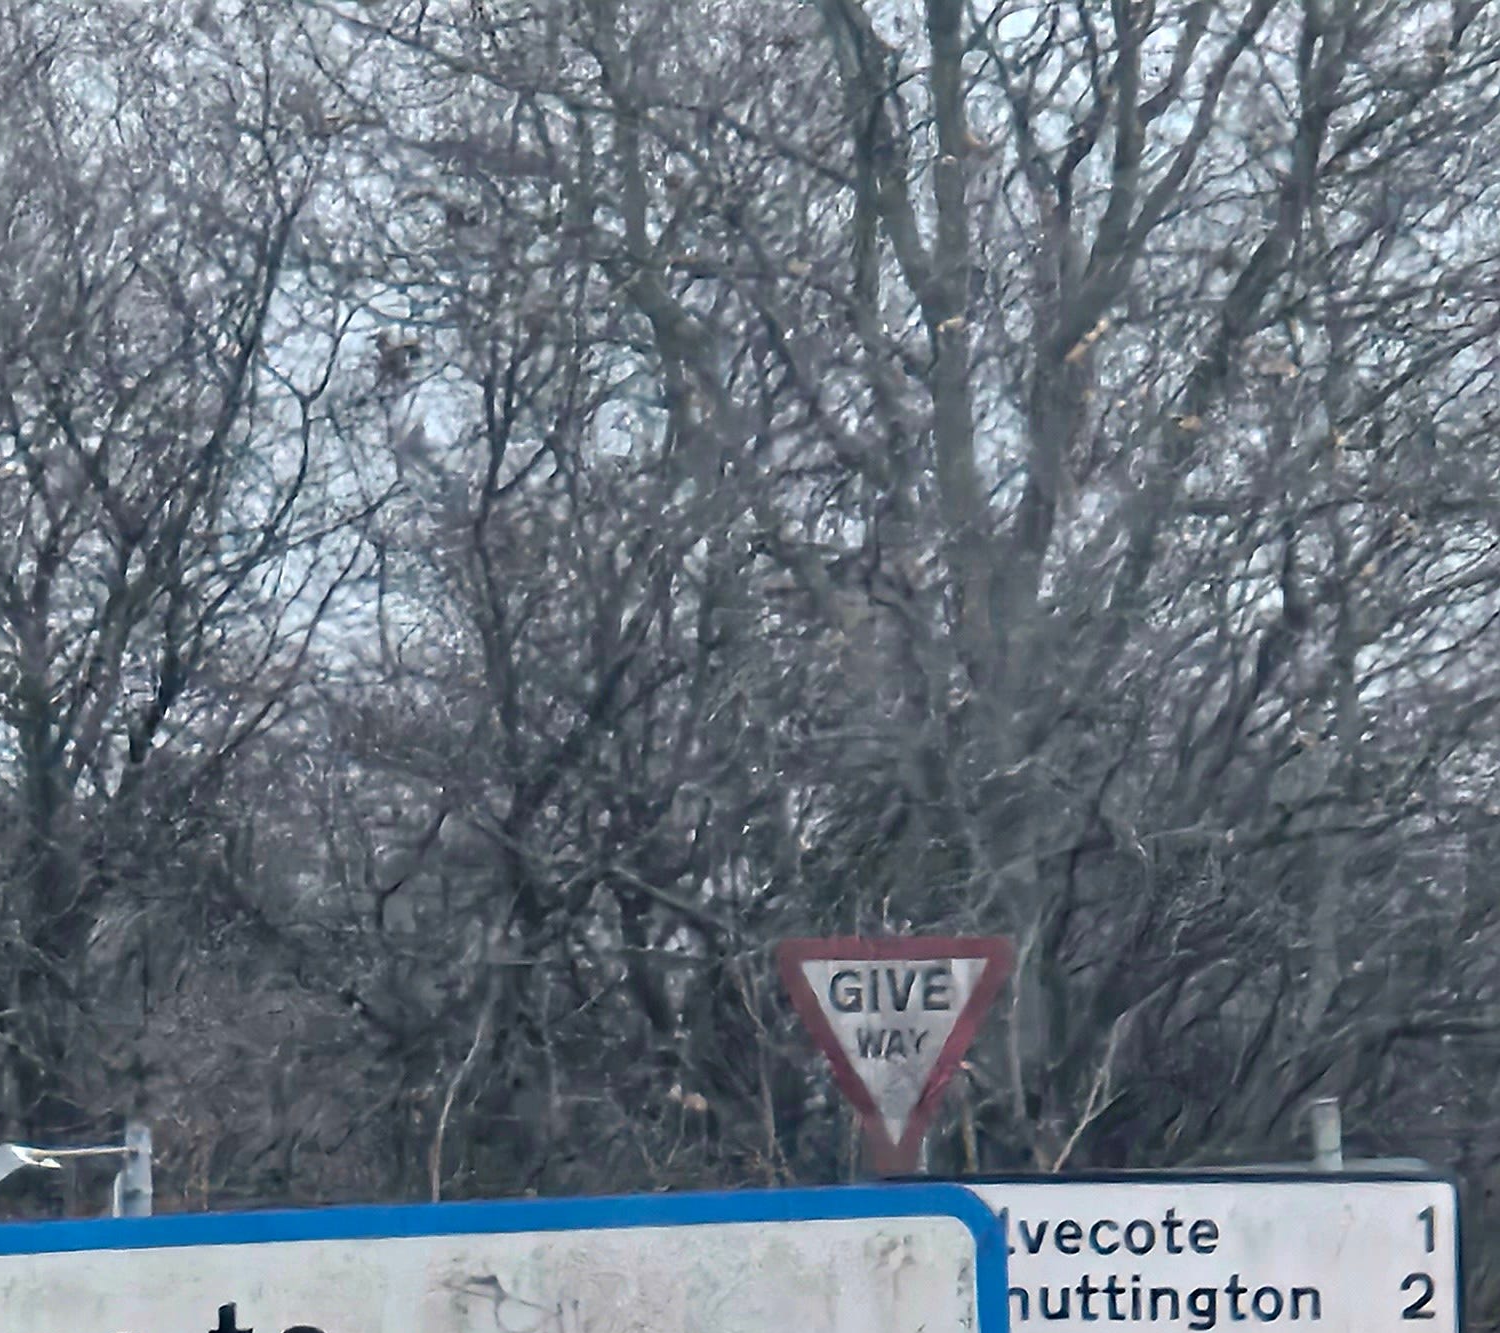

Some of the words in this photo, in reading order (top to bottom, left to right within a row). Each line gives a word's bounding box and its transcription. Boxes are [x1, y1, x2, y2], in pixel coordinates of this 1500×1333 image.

[829, 967, 952, 1013] GIVE
[856, 1026, 929, 1060] WAY
[1416, 1205, 1437, 1254] 1
[1399, 1271, 1437, 1320] 2
